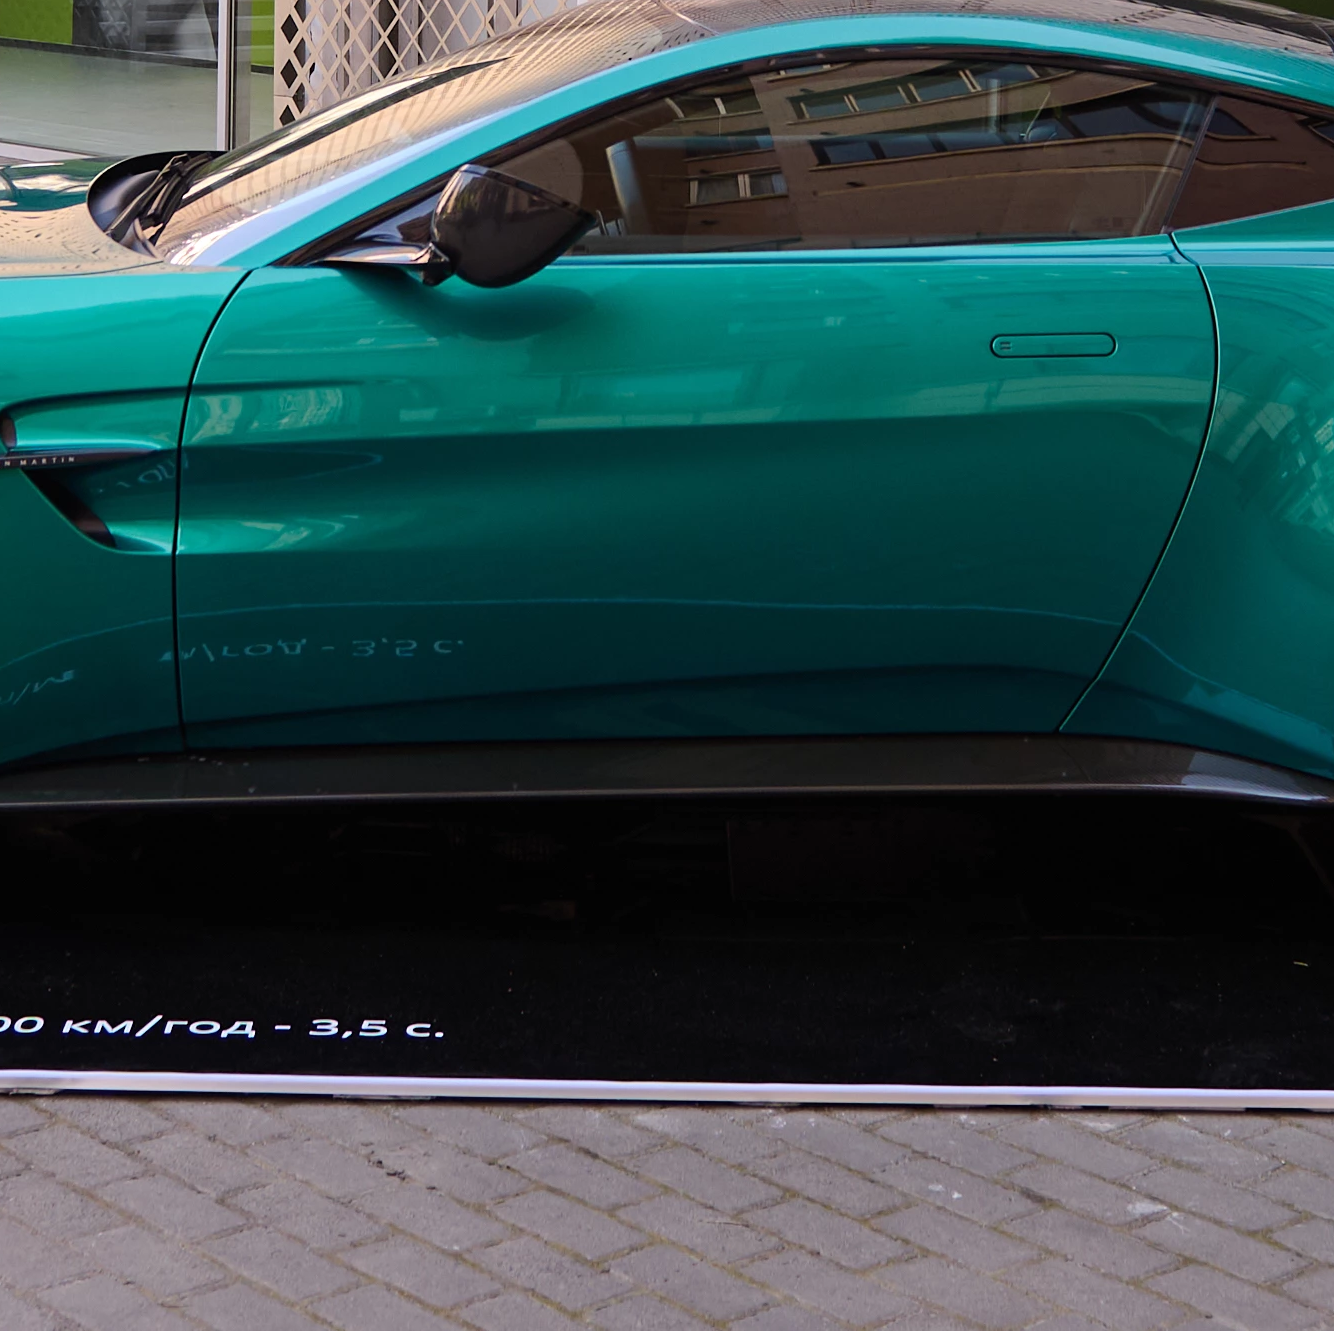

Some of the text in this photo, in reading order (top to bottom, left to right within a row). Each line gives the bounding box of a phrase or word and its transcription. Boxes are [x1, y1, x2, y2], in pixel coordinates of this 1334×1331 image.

[19, 455, 75, 466] MARTIN
[62, 1014, 256, 1039] км/год
[308, 1018, 388, 1039] 3,5
[405, 1023, 444, 1038] с.
